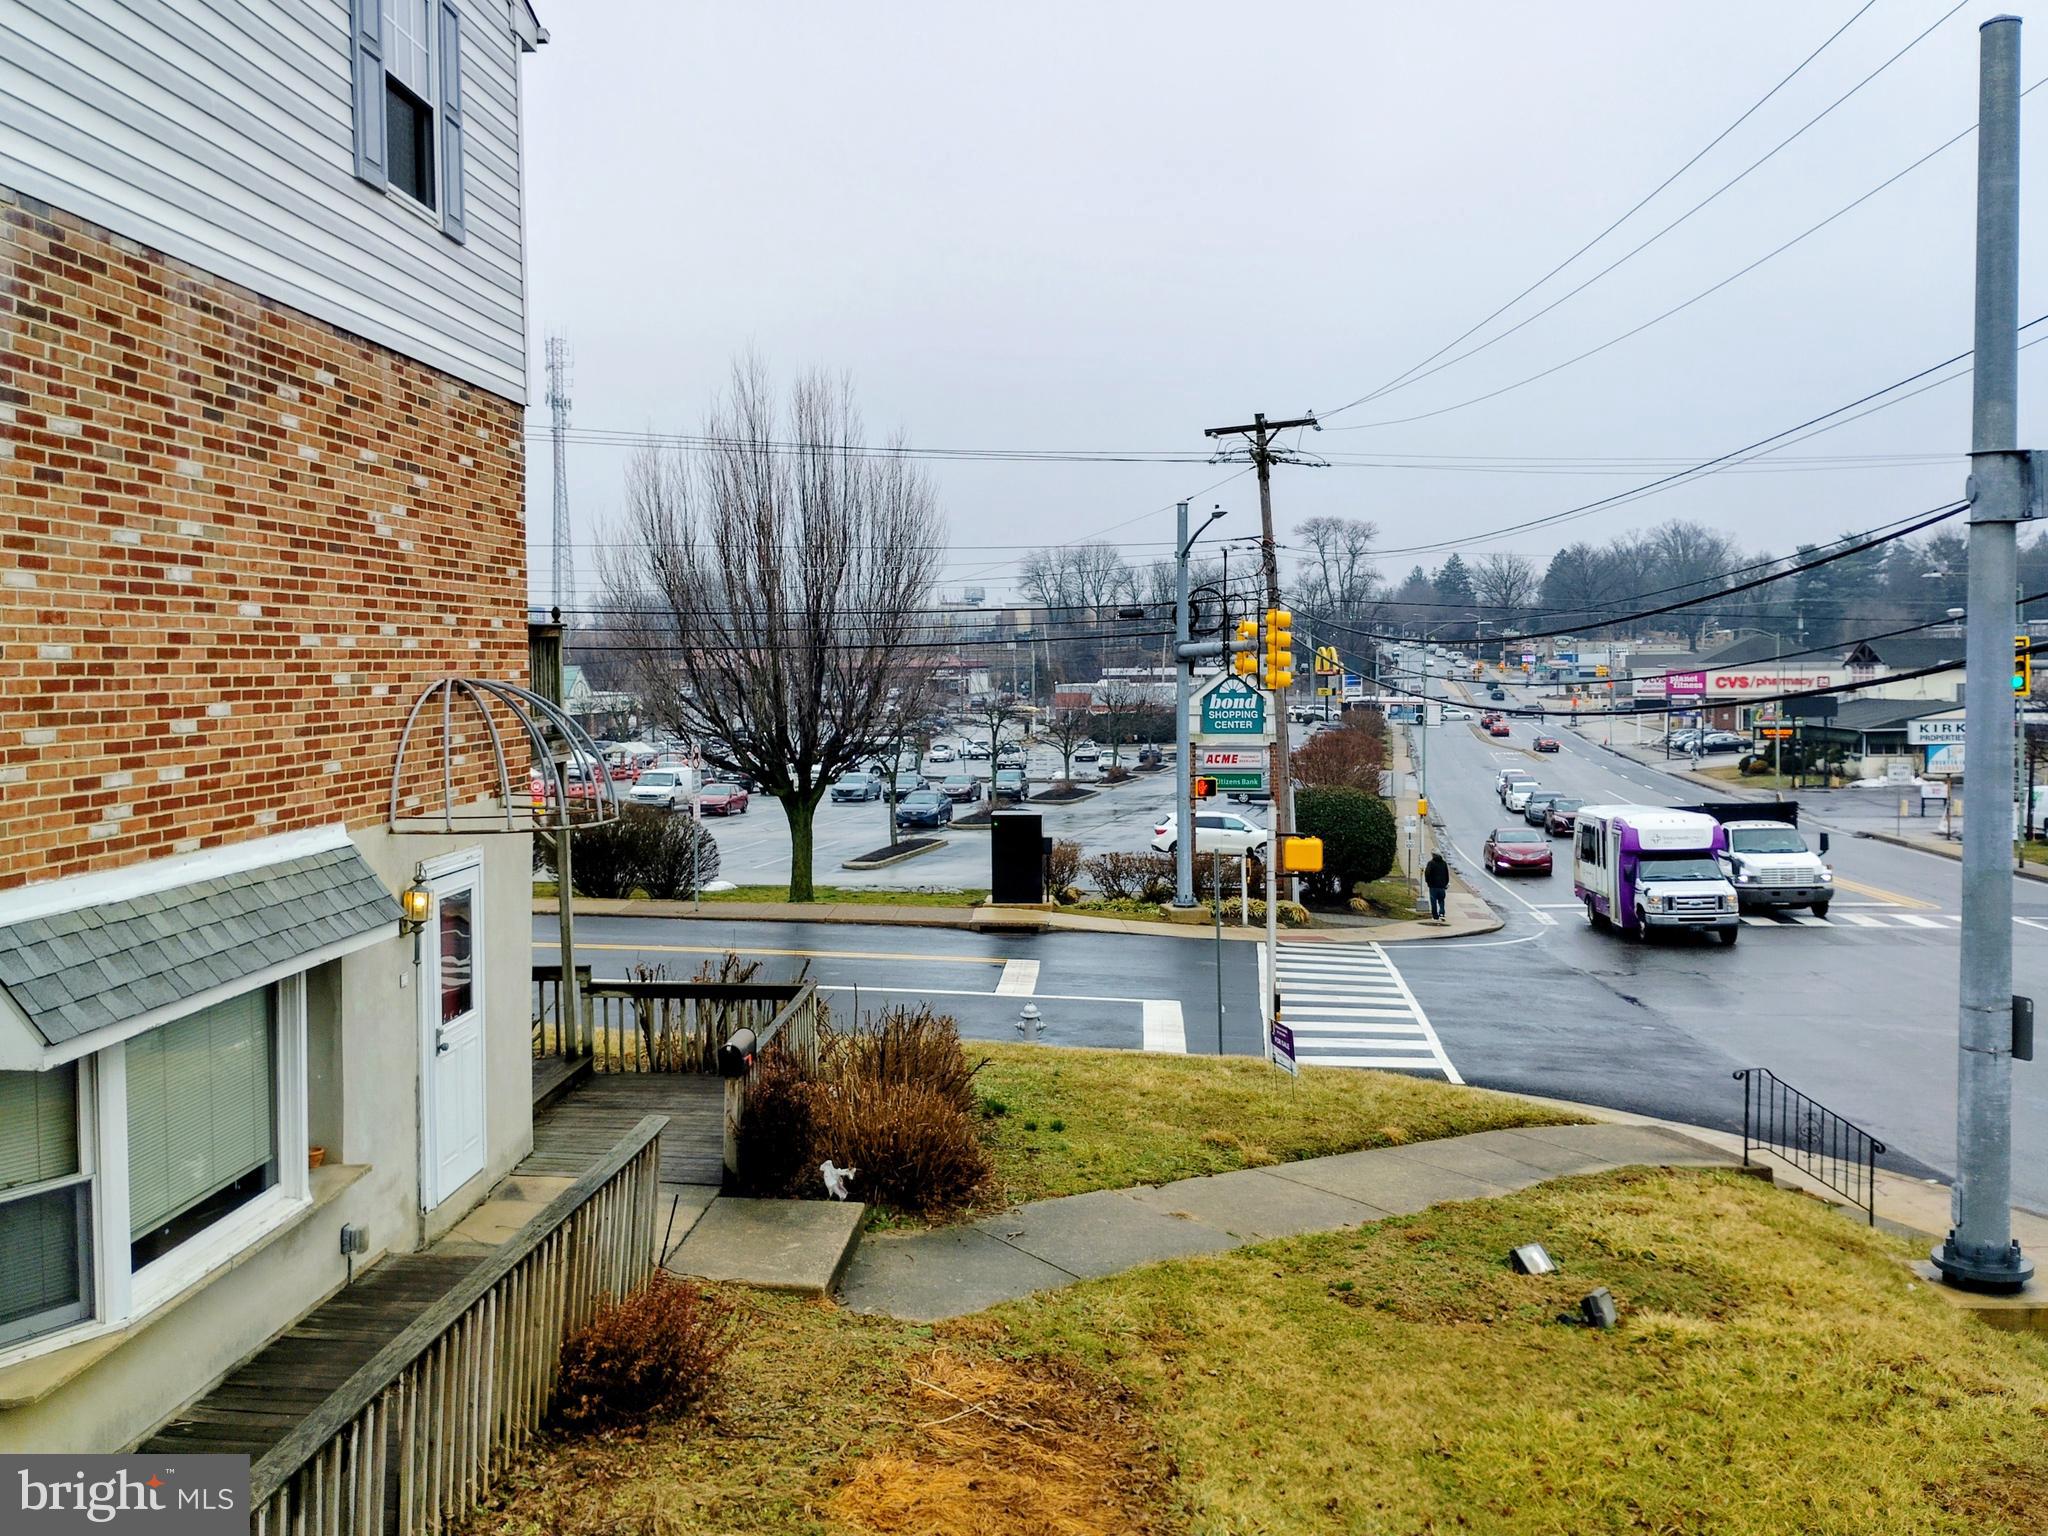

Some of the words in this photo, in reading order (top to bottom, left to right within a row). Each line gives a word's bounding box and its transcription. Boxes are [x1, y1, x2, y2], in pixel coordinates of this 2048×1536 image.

[1670, 675, 1698, 684] planet
[1209, 693, 1257, 708] bond
[1208, 710, 1258, 718] SHOPPING
[1214, 720, 1252, 728] CENTER
[1920, 724, 1965, 732] KIRK
[1206, 754, 1238, 763] ACME
